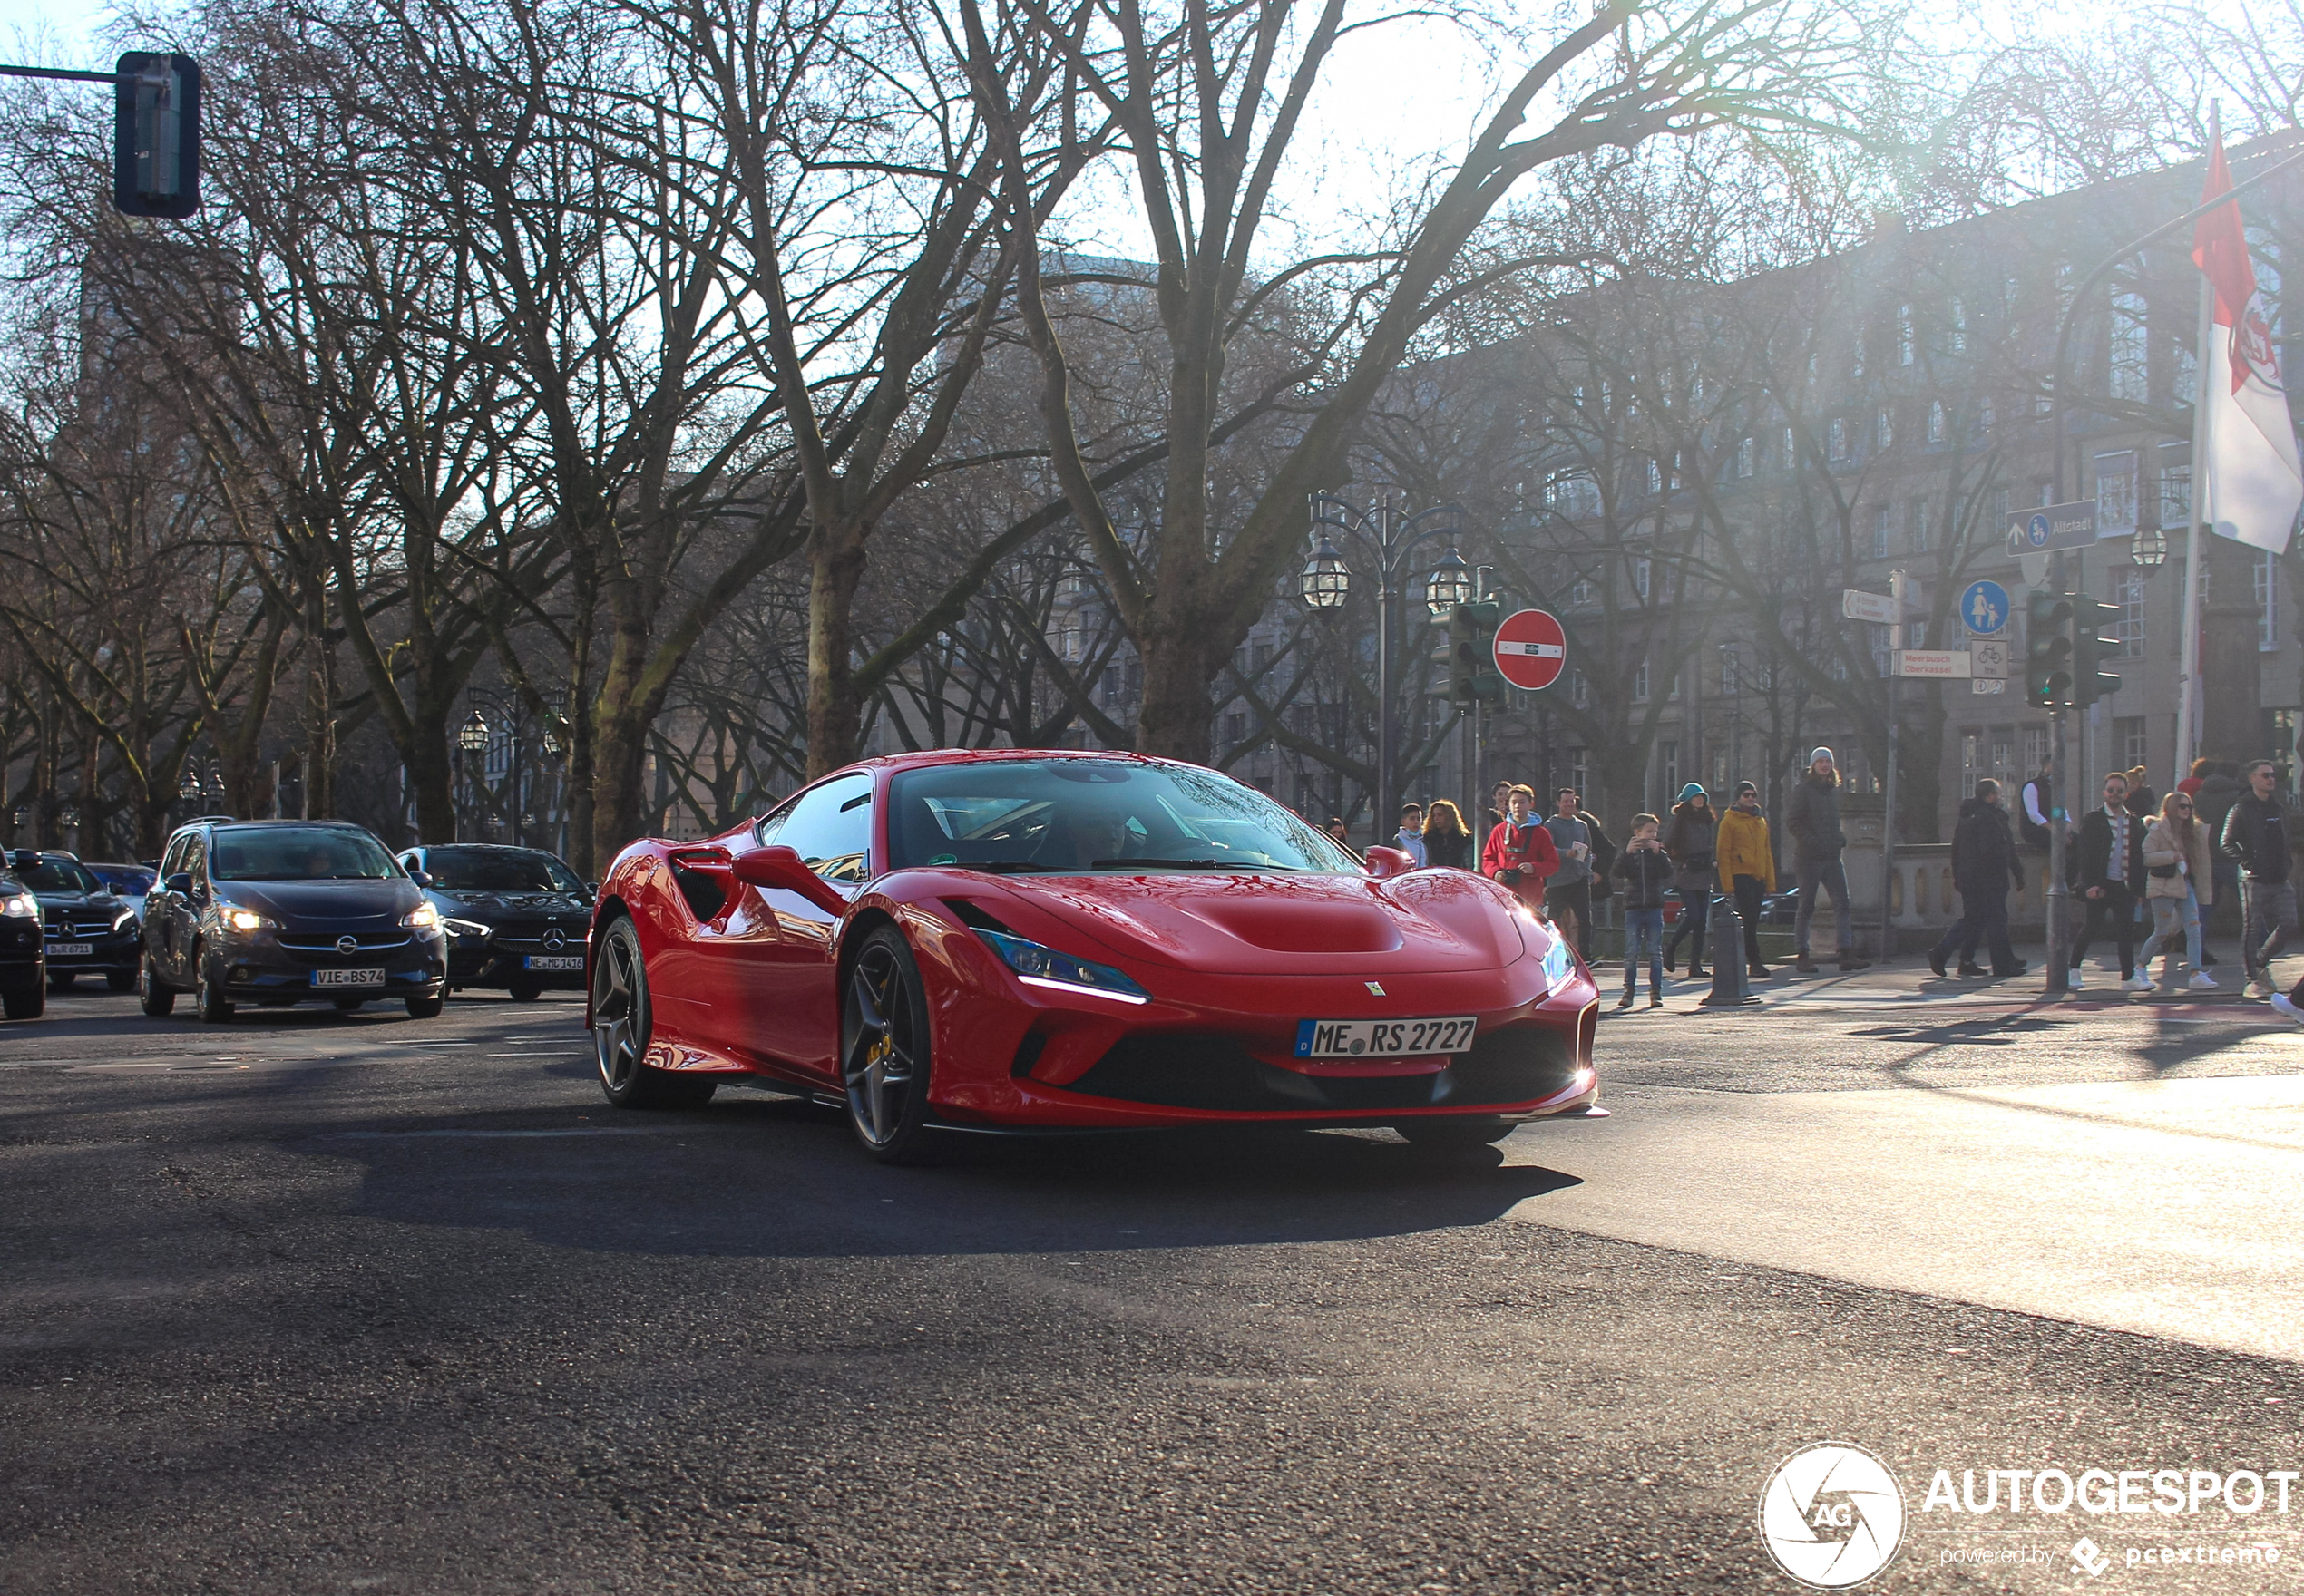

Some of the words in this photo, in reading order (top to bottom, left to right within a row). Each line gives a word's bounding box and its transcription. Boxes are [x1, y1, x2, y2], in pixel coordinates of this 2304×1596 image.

[2052, 517, 2092, 535] Altstadt
[1905, 655, 1951, 663] Meerbusch
[1905, 665, 1952, 674] Oberkassel
[318, 970, 344, 984] VIE
[1315, 1024, 1352, 1053] ME
[1369, 1023, 1405, 1052] RS
[1408, 1020, 1474, 1051] 2727
[1300, 1043, 1308, 1051] D
